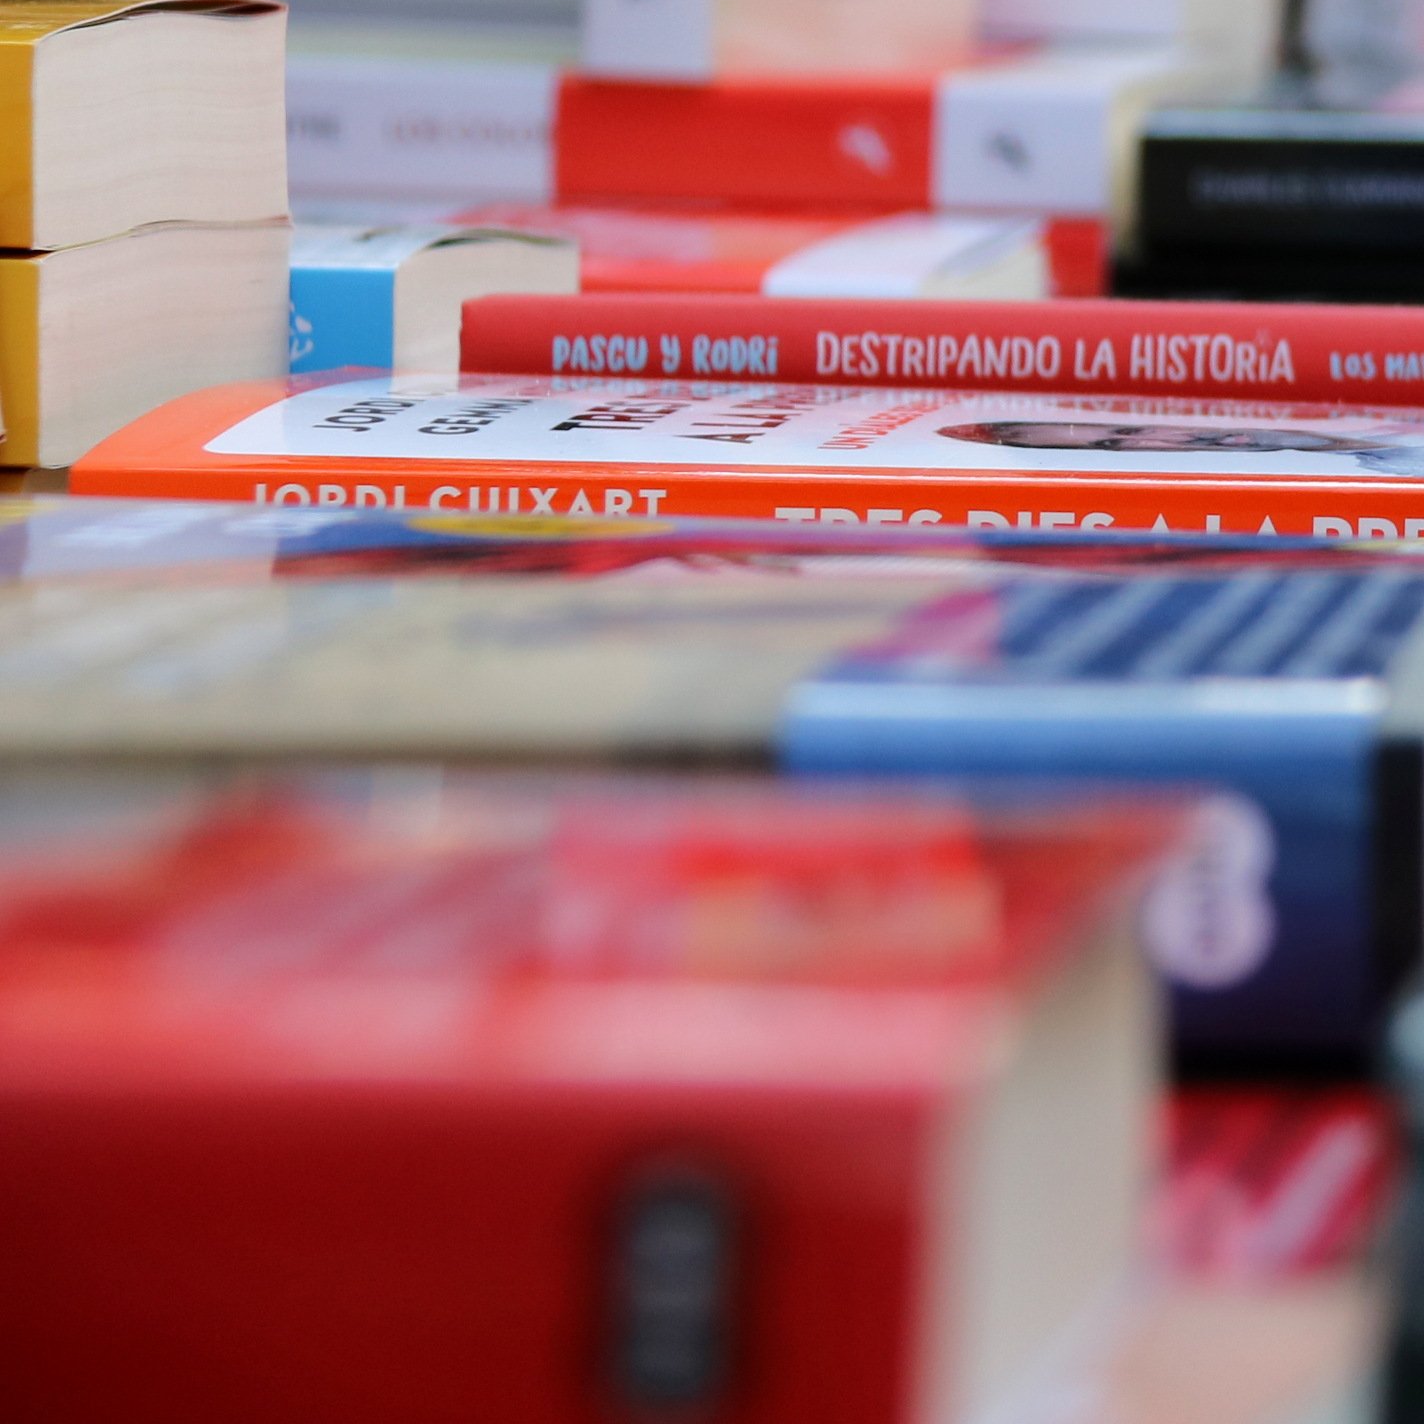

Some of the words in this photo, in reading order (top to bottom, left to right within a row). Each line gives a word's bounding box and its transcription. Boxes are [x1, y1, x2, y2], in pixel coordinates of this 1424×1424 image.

[553, 335, 647, 372] PASCU
[816, 331, 1061, 377] DESTRIPANDO
[1074, 337, 1116, 379] LA
[1329, 351, 1376, 381] LOS
[429, 486, 668, 517] CUIXART
